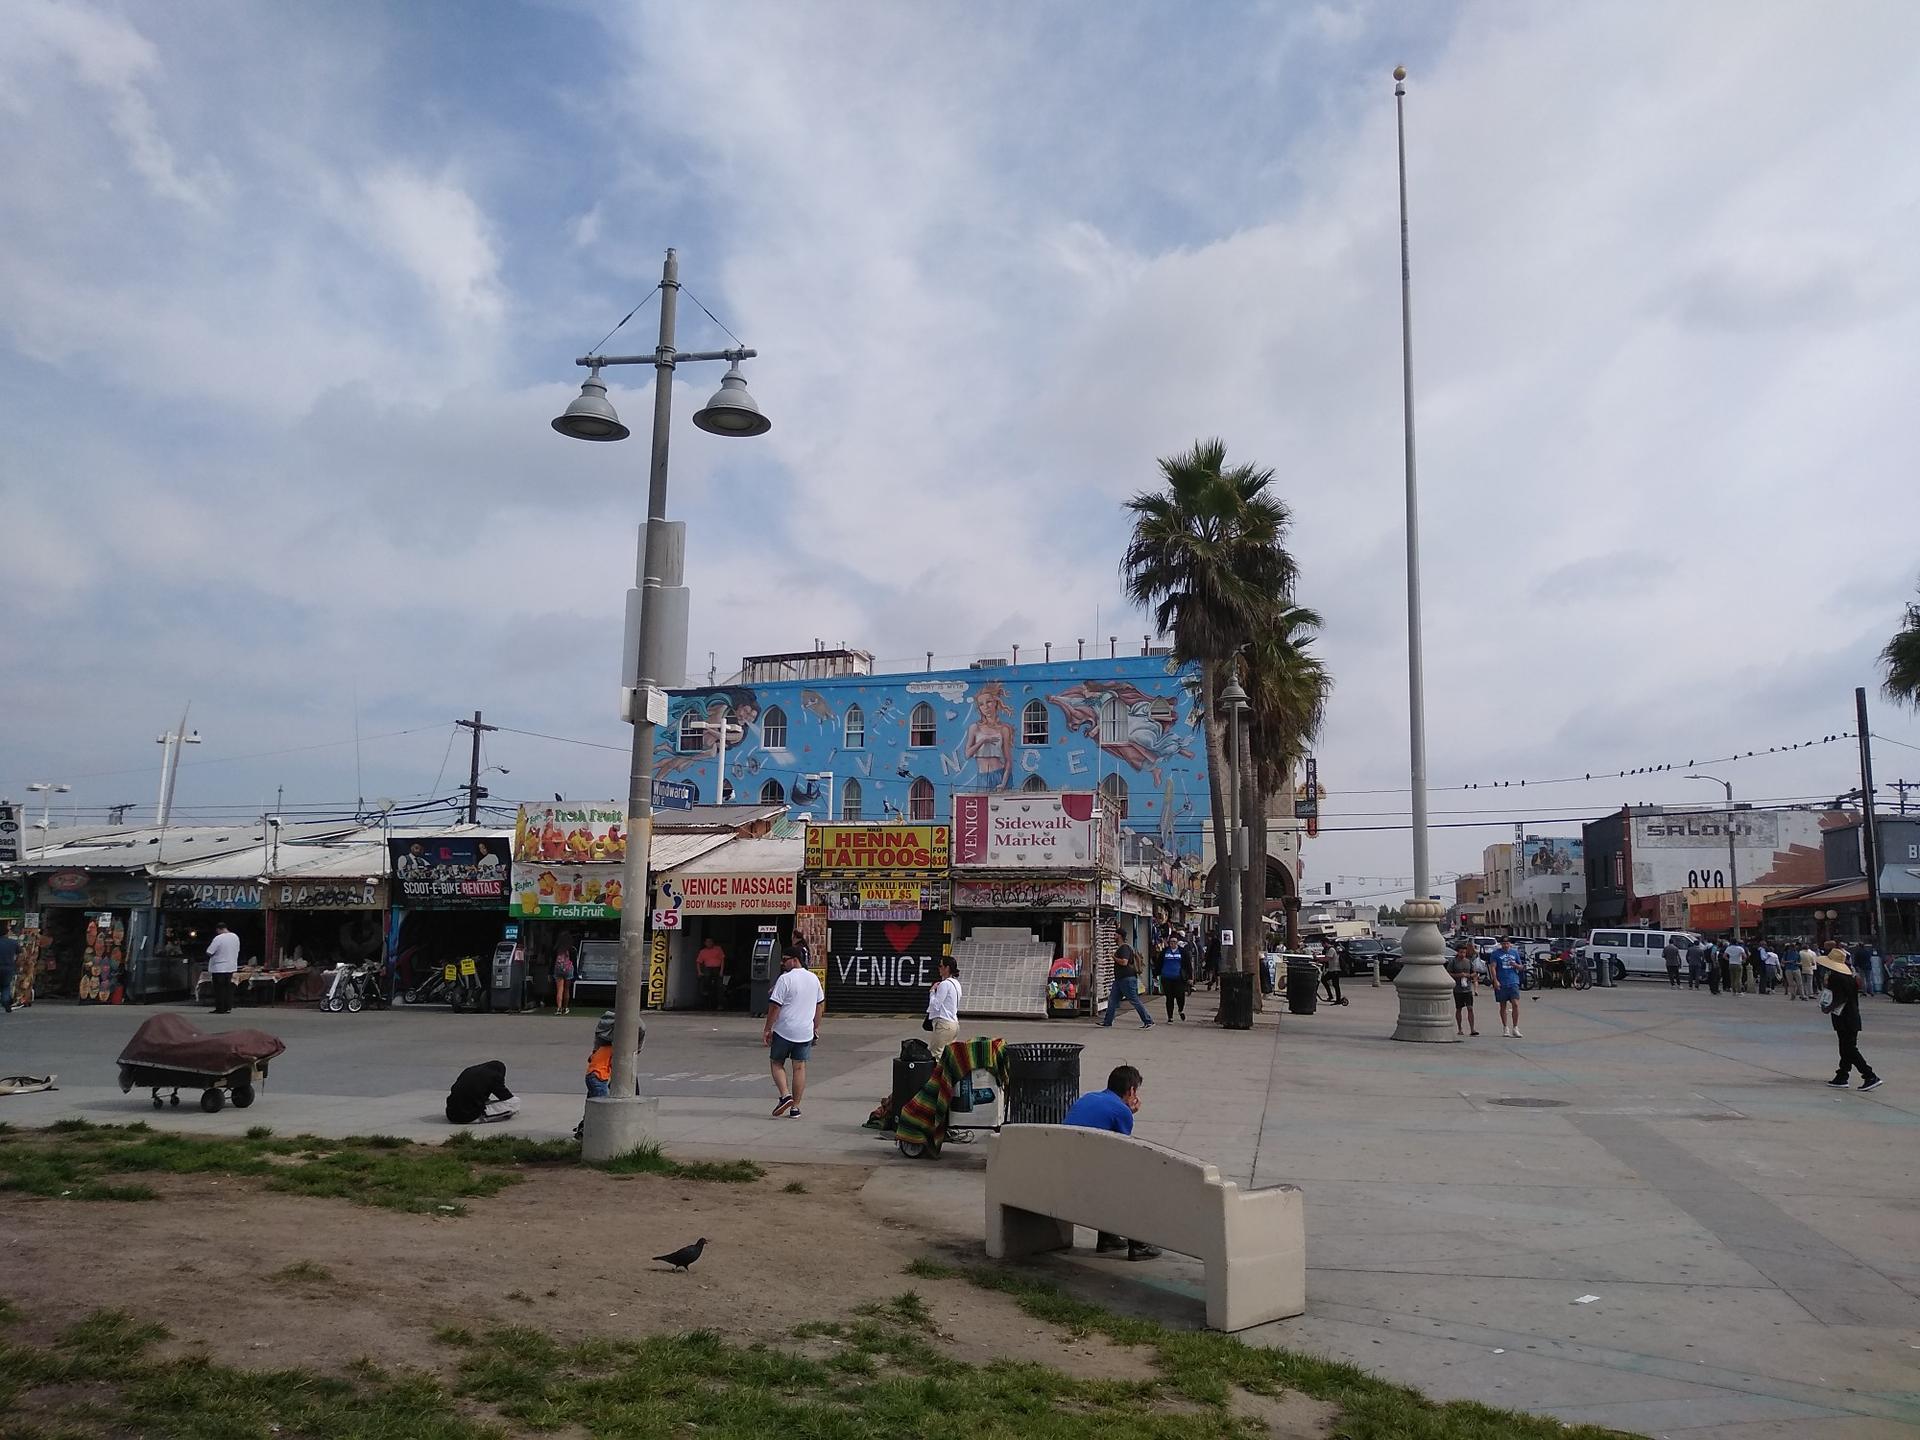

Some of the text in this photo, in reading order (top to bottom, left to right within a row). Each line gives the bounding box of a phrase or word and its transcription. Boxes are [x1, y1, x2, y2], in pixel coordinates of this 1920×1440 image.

[855, 749, 1089, 777] VENCE
[1307, 761, 1316, 799] BAR
[555, 809, 586, 823] Fresh
[590, 809, 624, 823] Fruit
[994, 816, 1073, 830] Sidewalk
[809, 828, 820, 845] 2
[935, 827, 946, 845] 2
[964, 799, 978, 860] VENICE
[835, 832, 920, 848] HENNA
[994, 834, 1057, 847] Market
[806, 847, 820, 855] FOR
[823, 848, 931, 867] TATTOOS
[932, 846, 947, 854] FOR
[1908, 844, 1920, 859] B
[806, 856, 821, 866] $10
[931, 856, 947, 866] $10
[681, 877, 794, 896] VENICE MASSAGE
[860, 881, 920, 889] ANY SMALL PRINT
[1688, 869, 1724, 888] AYA
[166, 884, 263, 904] EYPTIAN
[280, 884, 376, 905] BAZAR
[403, 881, 501, 895] SCOOT-E-BIKE RENTALS
[866, 889, 911, 900] ONLY $5
[552, 905, 605, 917] Fresh Fruit
[685, 899, 705, 909] BODY
[706, 899, 737, 911] Massage
[740, 899, 759, 909] FOOT
[761, 899, 791, 911] Massage
[655, 909, 678, 927] $5
[855, 921, 863, 951] I
[650, 930, 667, 1002] ASSAGE
[835, 955, 933, 987] VENICE
